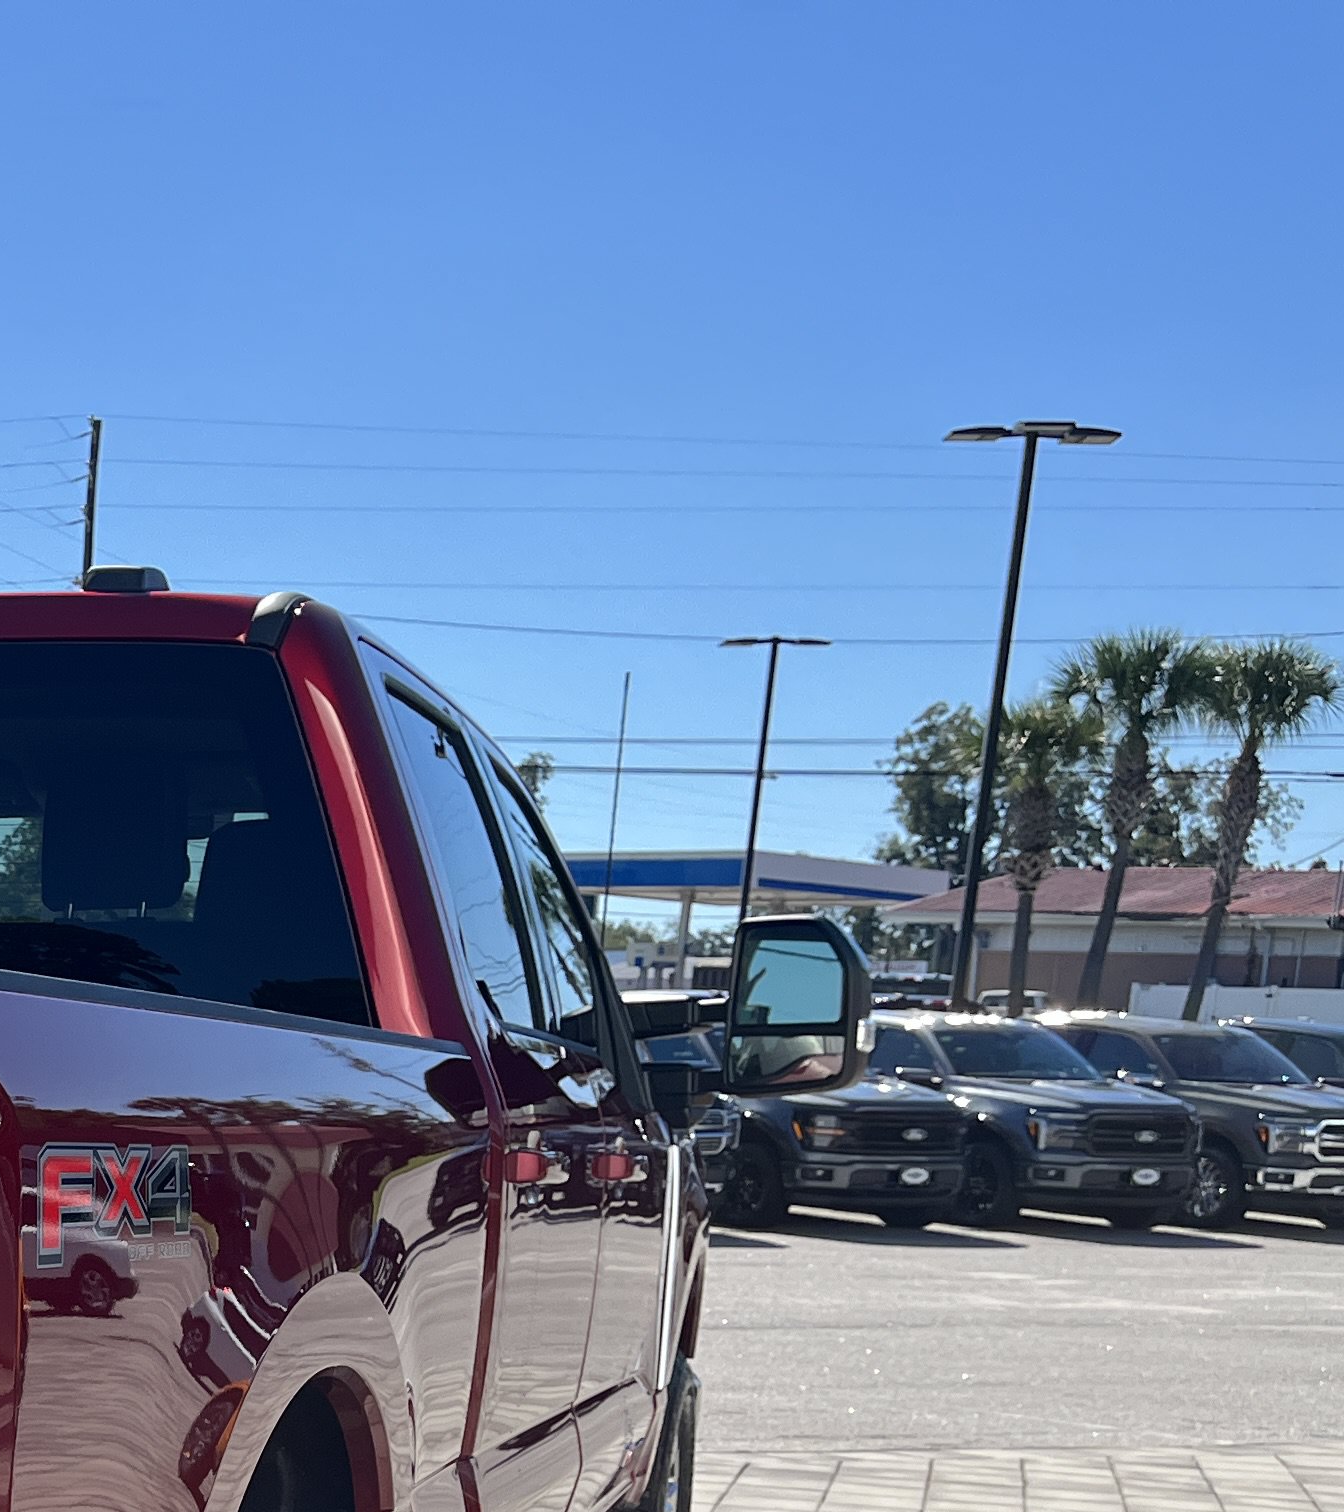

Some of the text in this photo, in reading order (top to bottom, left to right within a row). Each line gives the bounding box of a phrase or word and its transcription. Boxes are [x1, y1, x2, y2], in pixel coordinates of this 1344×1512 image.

[36, 1141, 192, 1270] FX4
[128, 1241, 192, 1261] OFF ROAD
